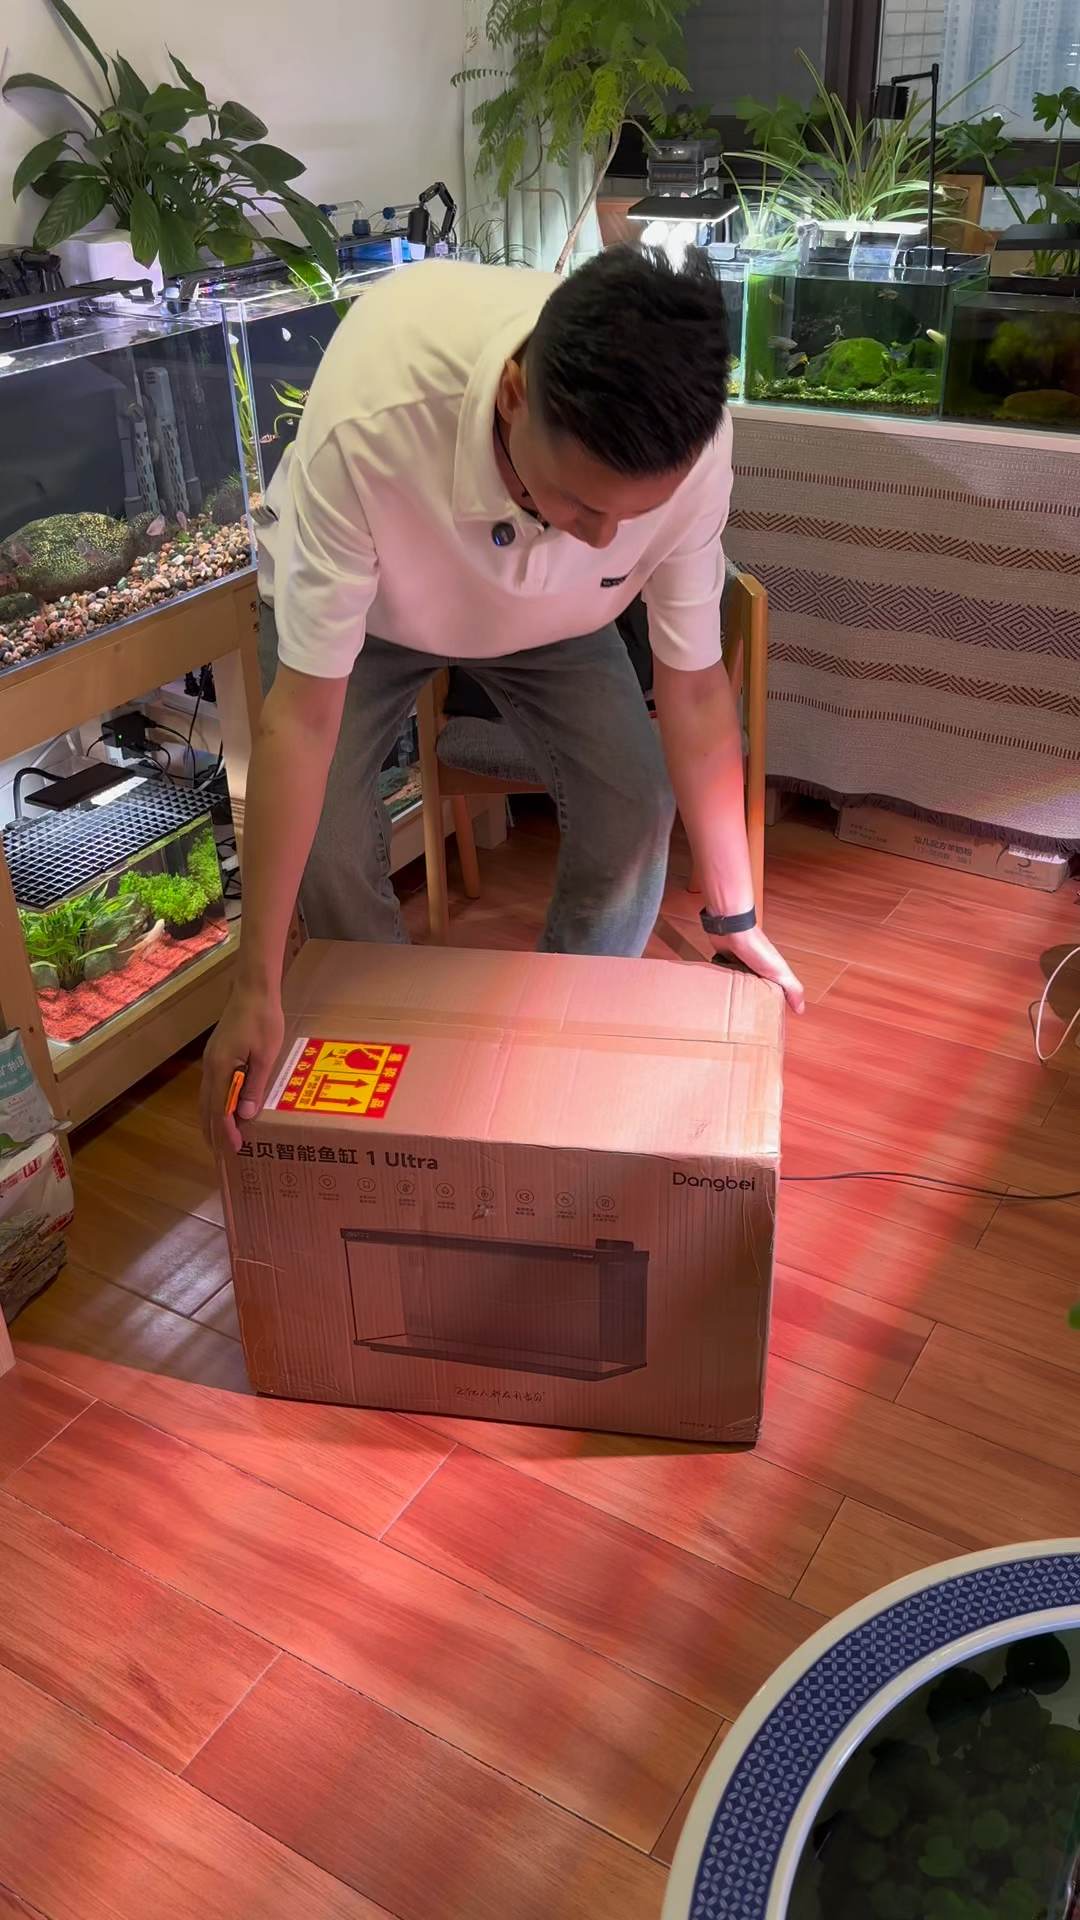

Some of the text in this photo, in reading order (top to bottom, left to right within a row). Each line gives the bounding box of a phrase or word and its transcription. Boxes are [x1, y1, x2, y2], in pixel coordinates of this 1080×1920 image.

[237, 1140, 439, 1170] 当贝智能鱼缸 1 Ultra
[672, 1171, 756, 1192] Dangbei
